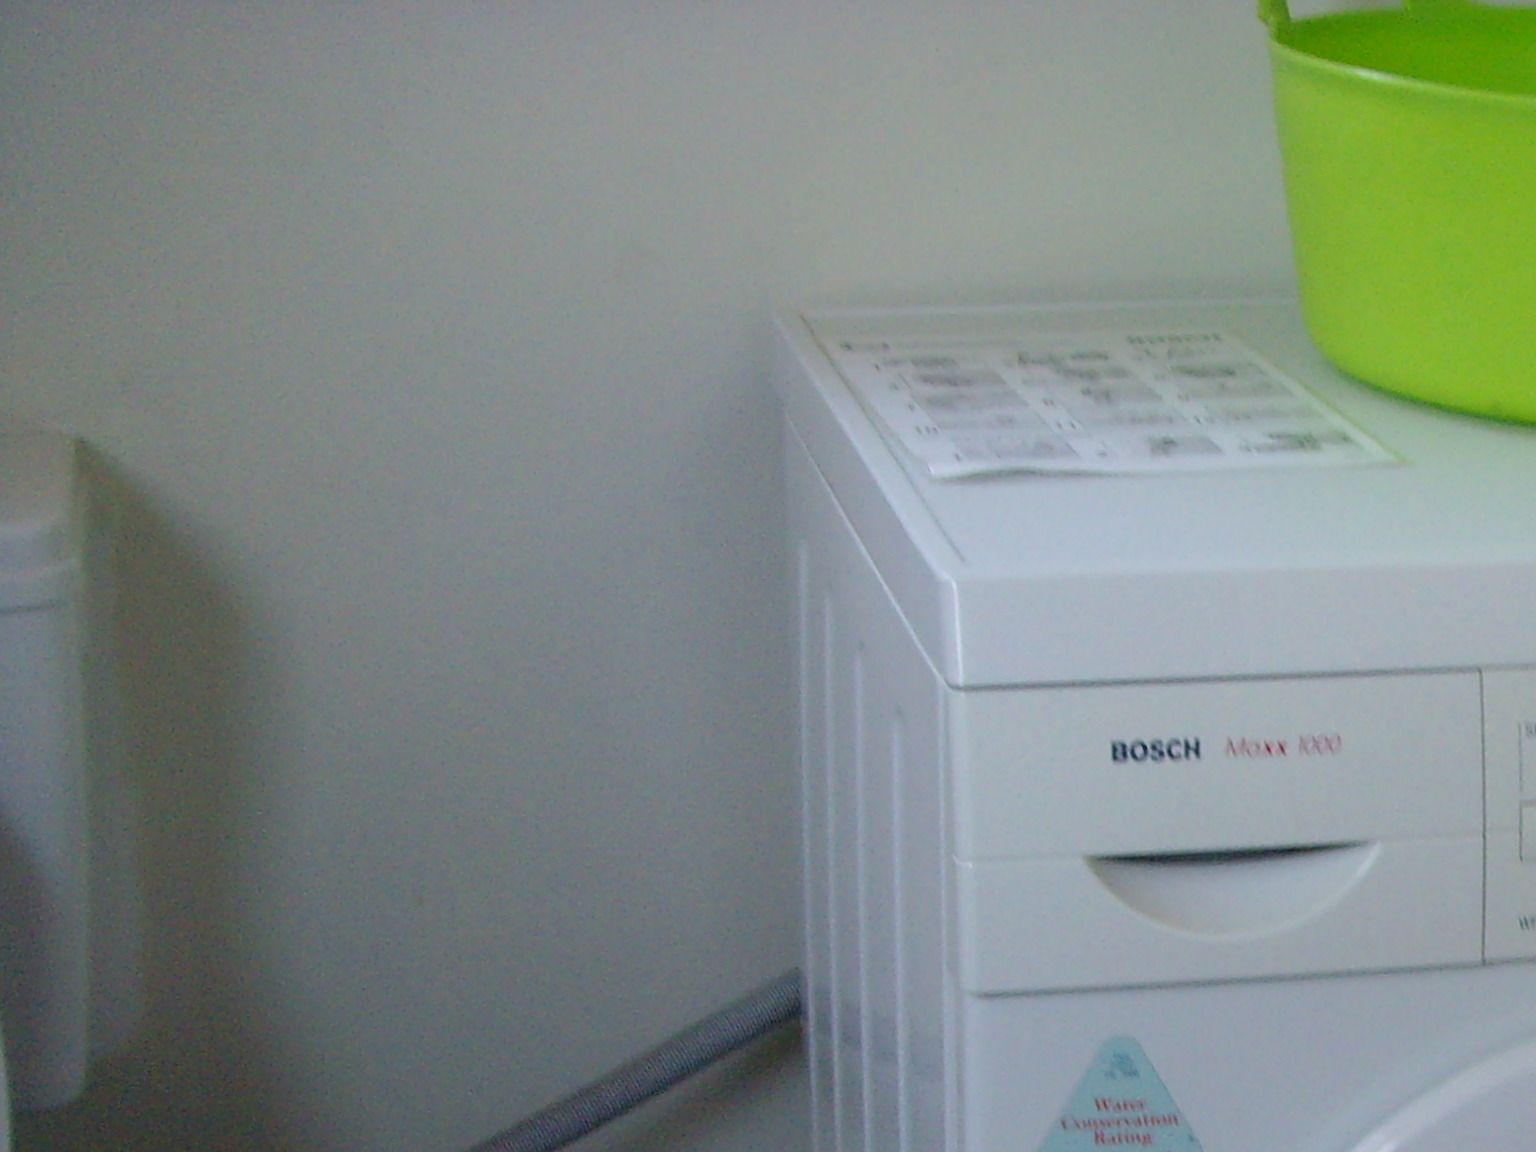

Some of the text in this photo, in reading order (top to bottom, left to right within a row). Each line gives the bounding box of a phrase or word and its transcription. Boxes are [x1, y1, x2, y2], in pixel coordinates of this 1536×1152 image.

[1110, 736, 1202, 762] BOSCH
[1298, 733, 1343, 756] 1000
[1094, 1098, 1147, 1113] Water
[1060, 1113, 1180, 1132] Conservation
[1093, 1131, 1152, 1148] Rating
